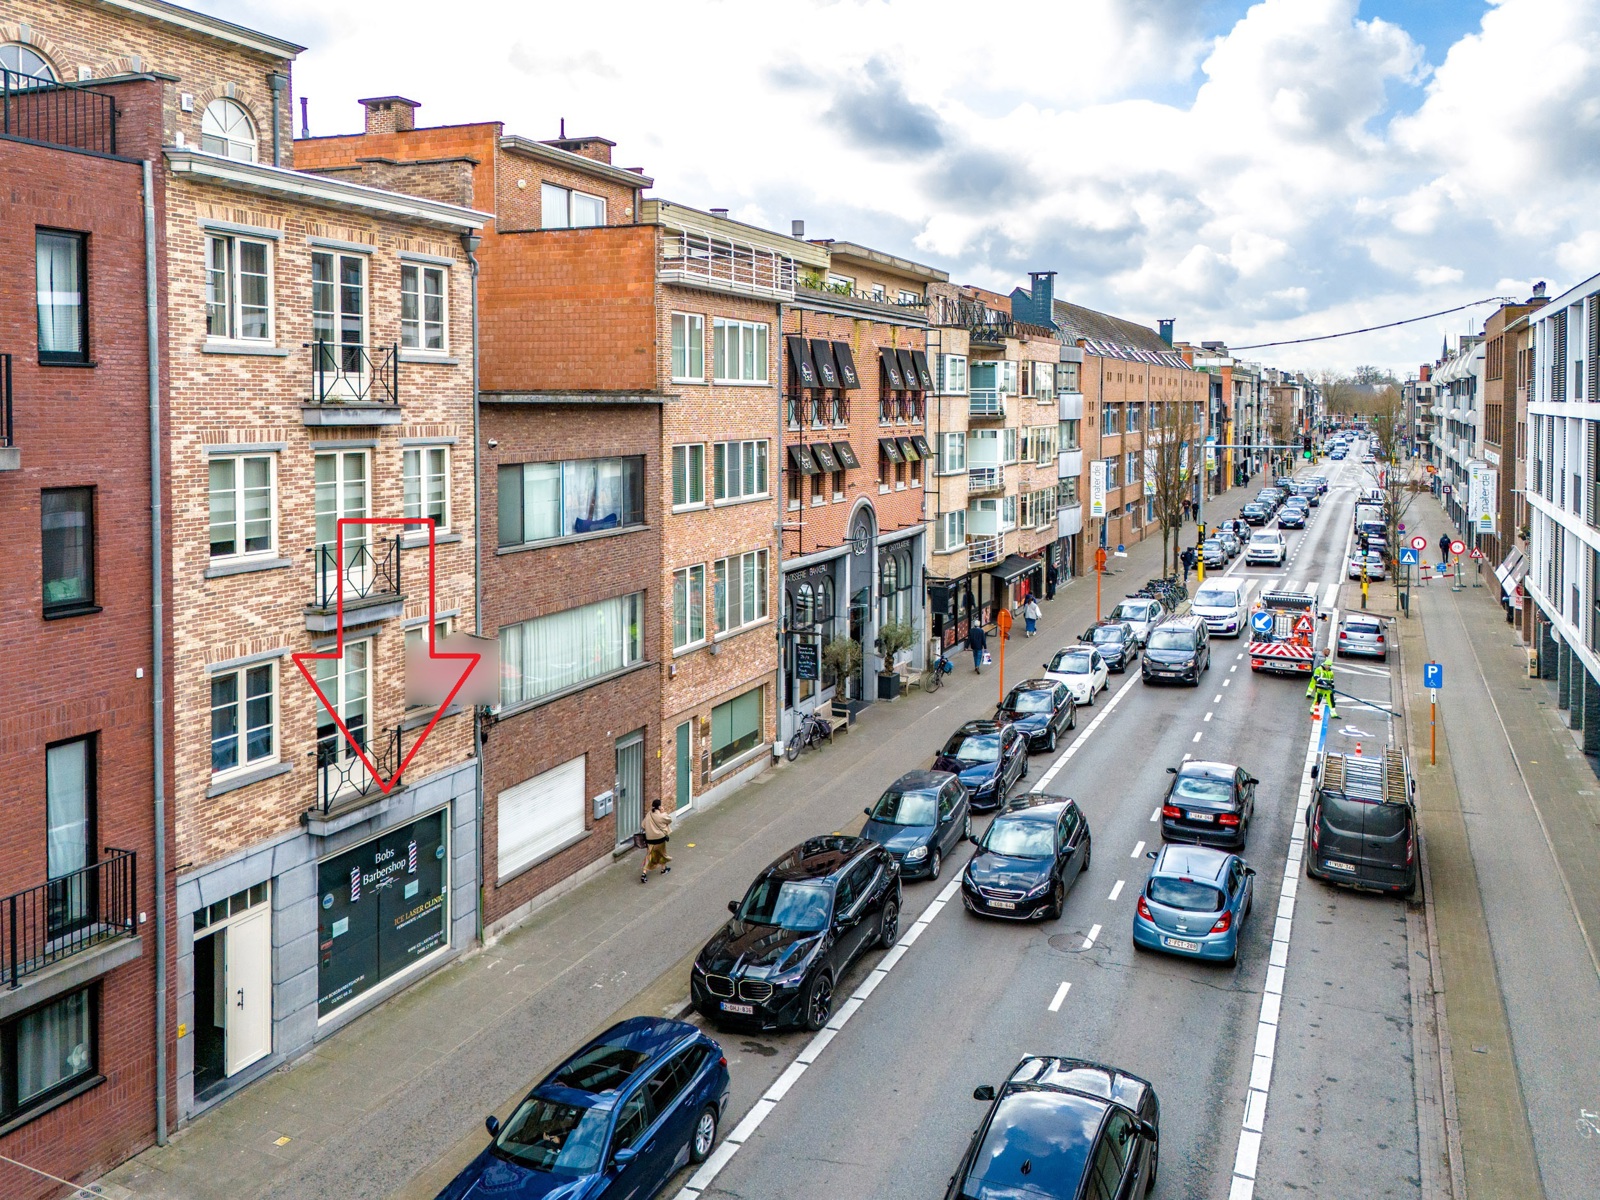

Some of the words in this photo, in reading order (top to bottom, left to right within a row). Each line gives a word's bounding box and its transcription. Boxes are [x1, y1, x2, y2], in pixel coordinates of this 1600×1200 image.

[1480, 473, 1490, 486] dei
[1480, 488, 1490, 513] mater
[1427, 665, 1438, 678] P
[375, 848, 395, 864] Bobs
[363, 859, 406, 885] Barbershop
[394, 914, 405, 926] ICE
[405, 904, 424, 921] LASER
[424, 893, 445, 910] CLINIC
